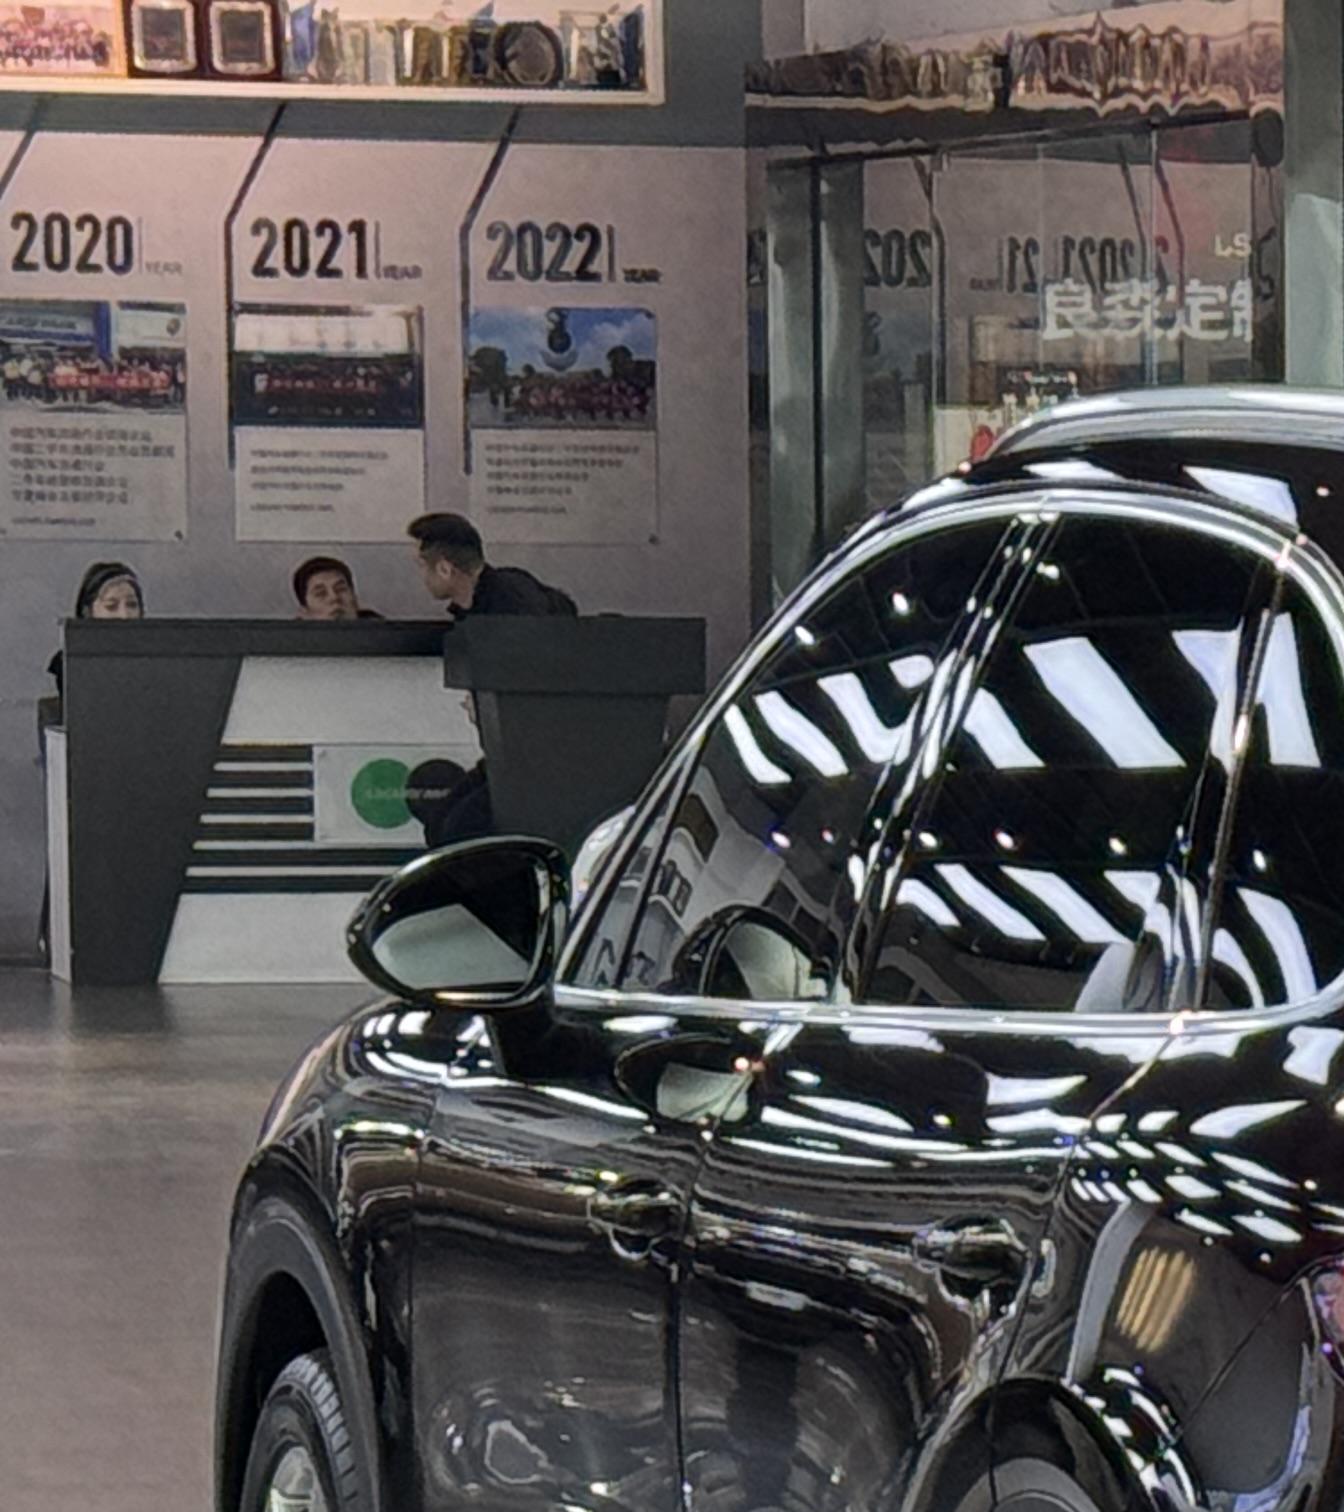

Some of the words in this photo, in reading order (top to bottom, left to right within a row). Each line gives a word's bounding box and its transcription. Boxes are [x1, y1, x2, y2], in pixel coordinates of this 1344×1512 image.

[10, 211, 134, 275] 2020
[250, 217, 369, 280] 2021
[486, 220, 602, 283] 2022
